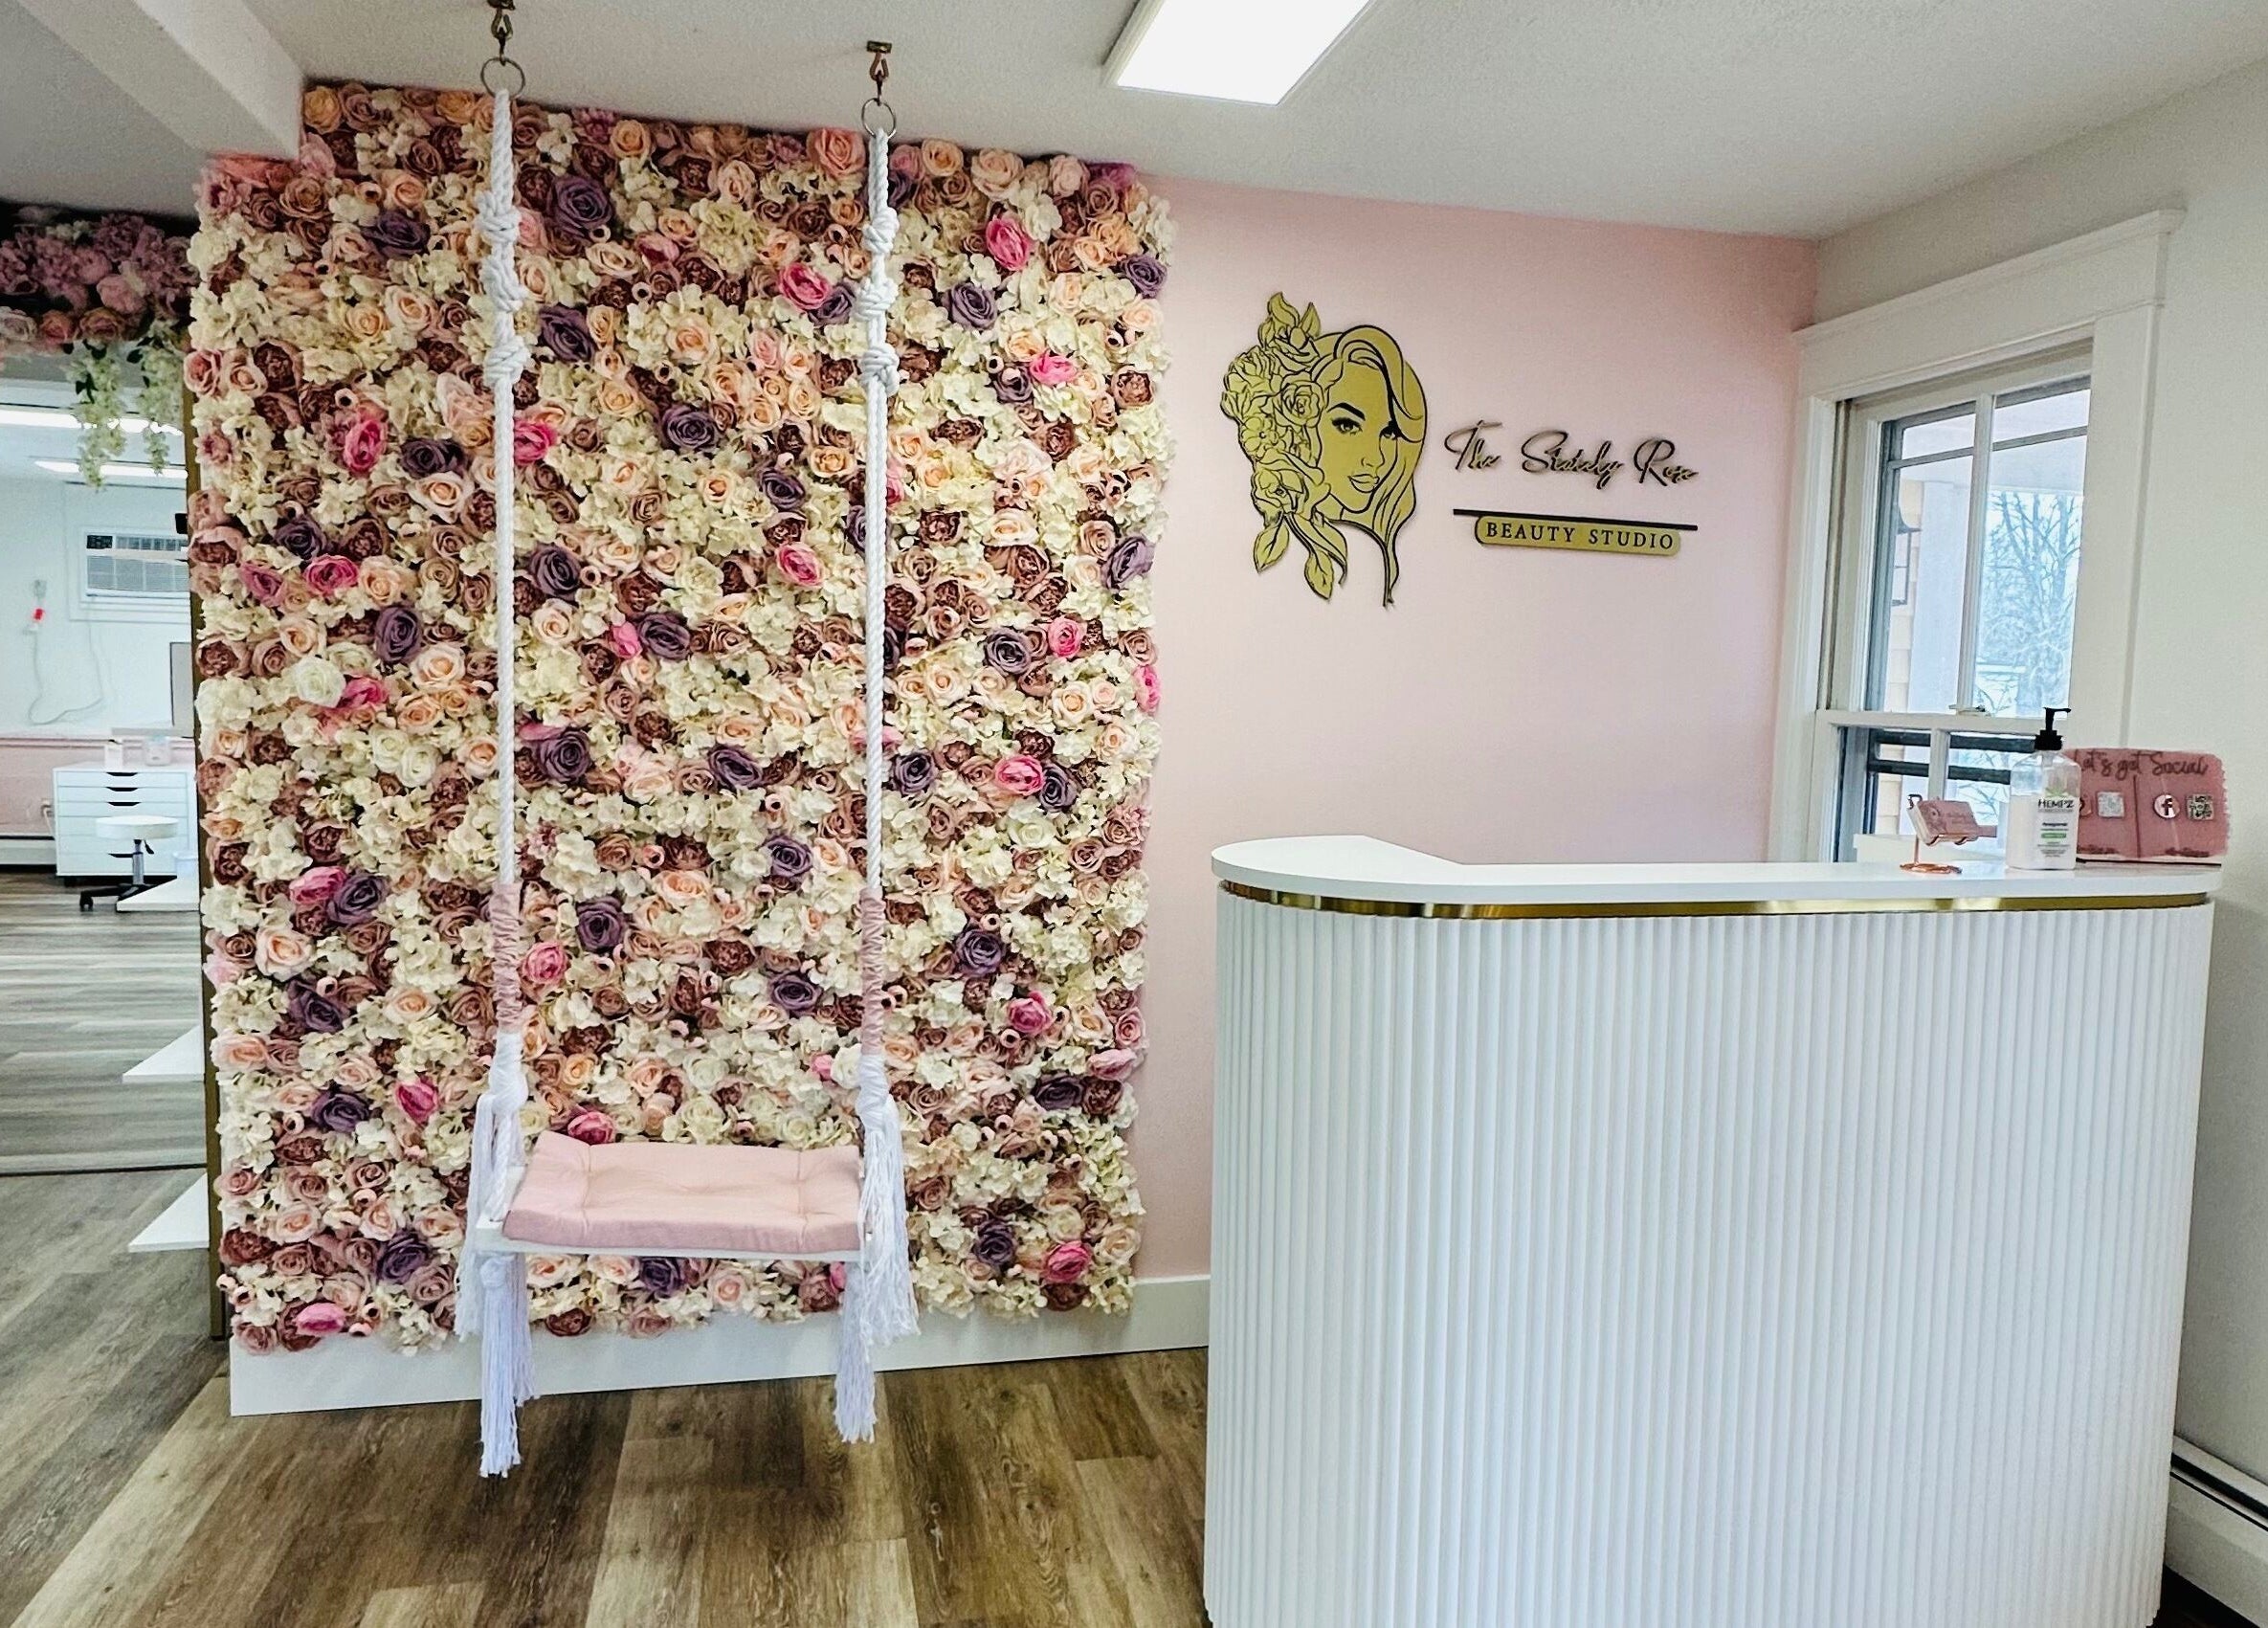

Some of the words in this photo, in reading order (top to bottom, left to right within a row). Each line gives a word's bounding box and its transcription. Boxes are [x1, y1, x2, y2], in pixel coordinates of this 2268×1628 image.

[1443, 419, 1502, 471] The
[1485, 522, 1576, 544] BEAUTY
[1588, 528, 1674, 550] STUDIO
